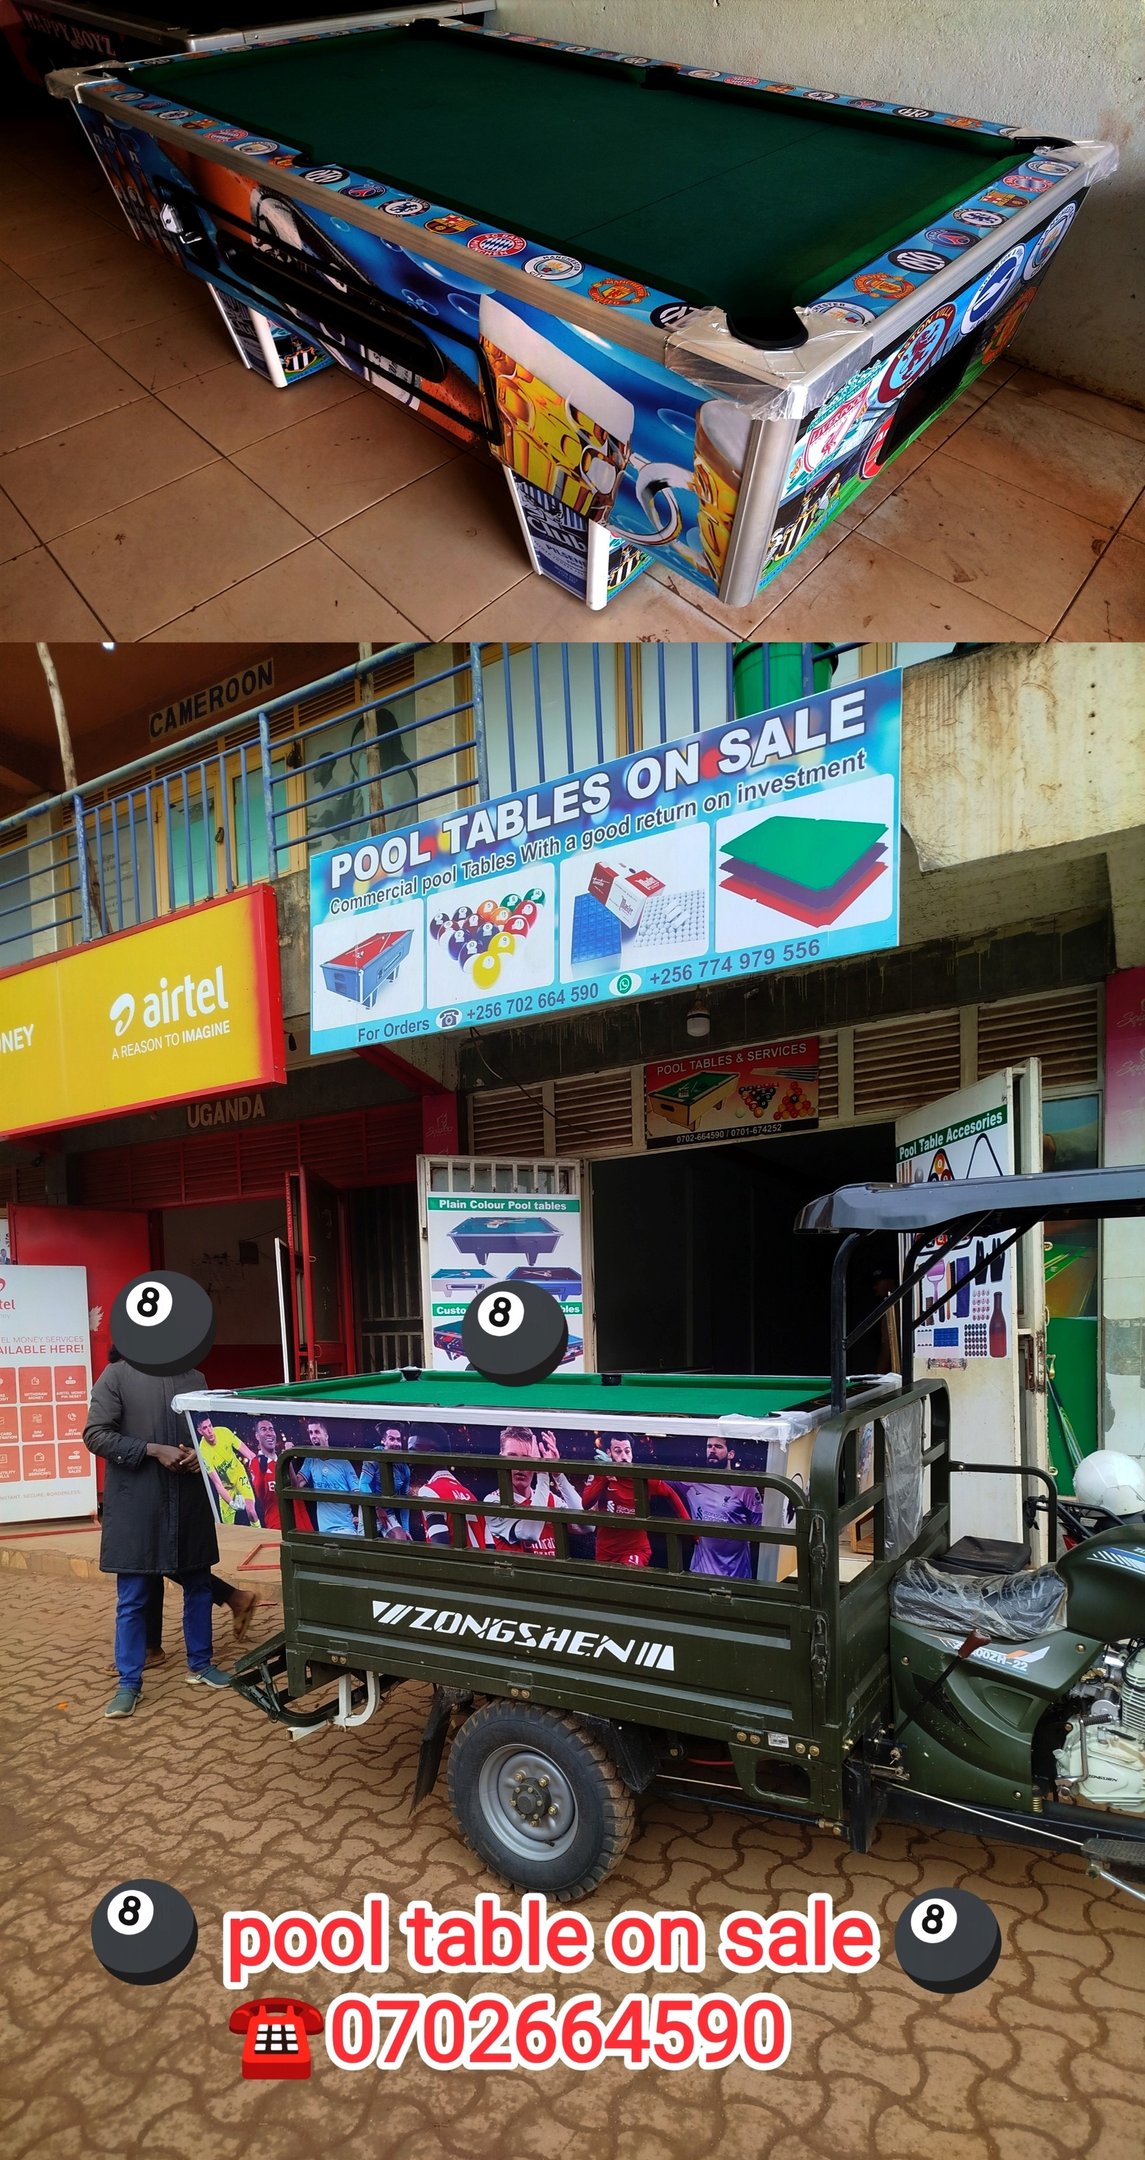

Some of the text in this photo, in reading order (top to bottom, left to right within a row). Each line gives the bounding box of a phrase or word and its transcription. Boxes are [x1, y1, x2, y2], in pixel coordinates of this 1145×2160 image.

[149, 660, 274, 739] CAMEROON
[331, 688, 867, 889] POOL TABLES ON SALE
[330, 749, 867, 915] Commercial pool Tables With a good return on investment
[142, 965, 229, 1029] airtel
[357, 938, 821, 1043] For Orders +256 702 664 590 +256 774 979 556
[0, 1023, 35, 1055] NEY
[111, 1019, 232, 1061] A REASON TO IMAGINE
[657, 1042, 807, 1076] POOL TABLES & SERVICES
[187, 1093, 267, 1129] UGANDA
[676, 1130, 725, 1144] 0702-664590
[731, 1123, 783, 1137] 0701-674252
[899, 1111, 1003, 1161] Pool Table Accesories
[439, 1199, 568, 1211] Plain Colour Pool tables
[0, 1299, 16, 1310] tel
[436, 1303, 580, 1315] Custo bles
[0, 1344, 84, 1355] AILABLE HERE!
[13, 1335, 44, 1344] MONEY
[46, 1335, 84, 1343] SERVICES
[408, 1606, 637, 1664] ZONGSHEN
